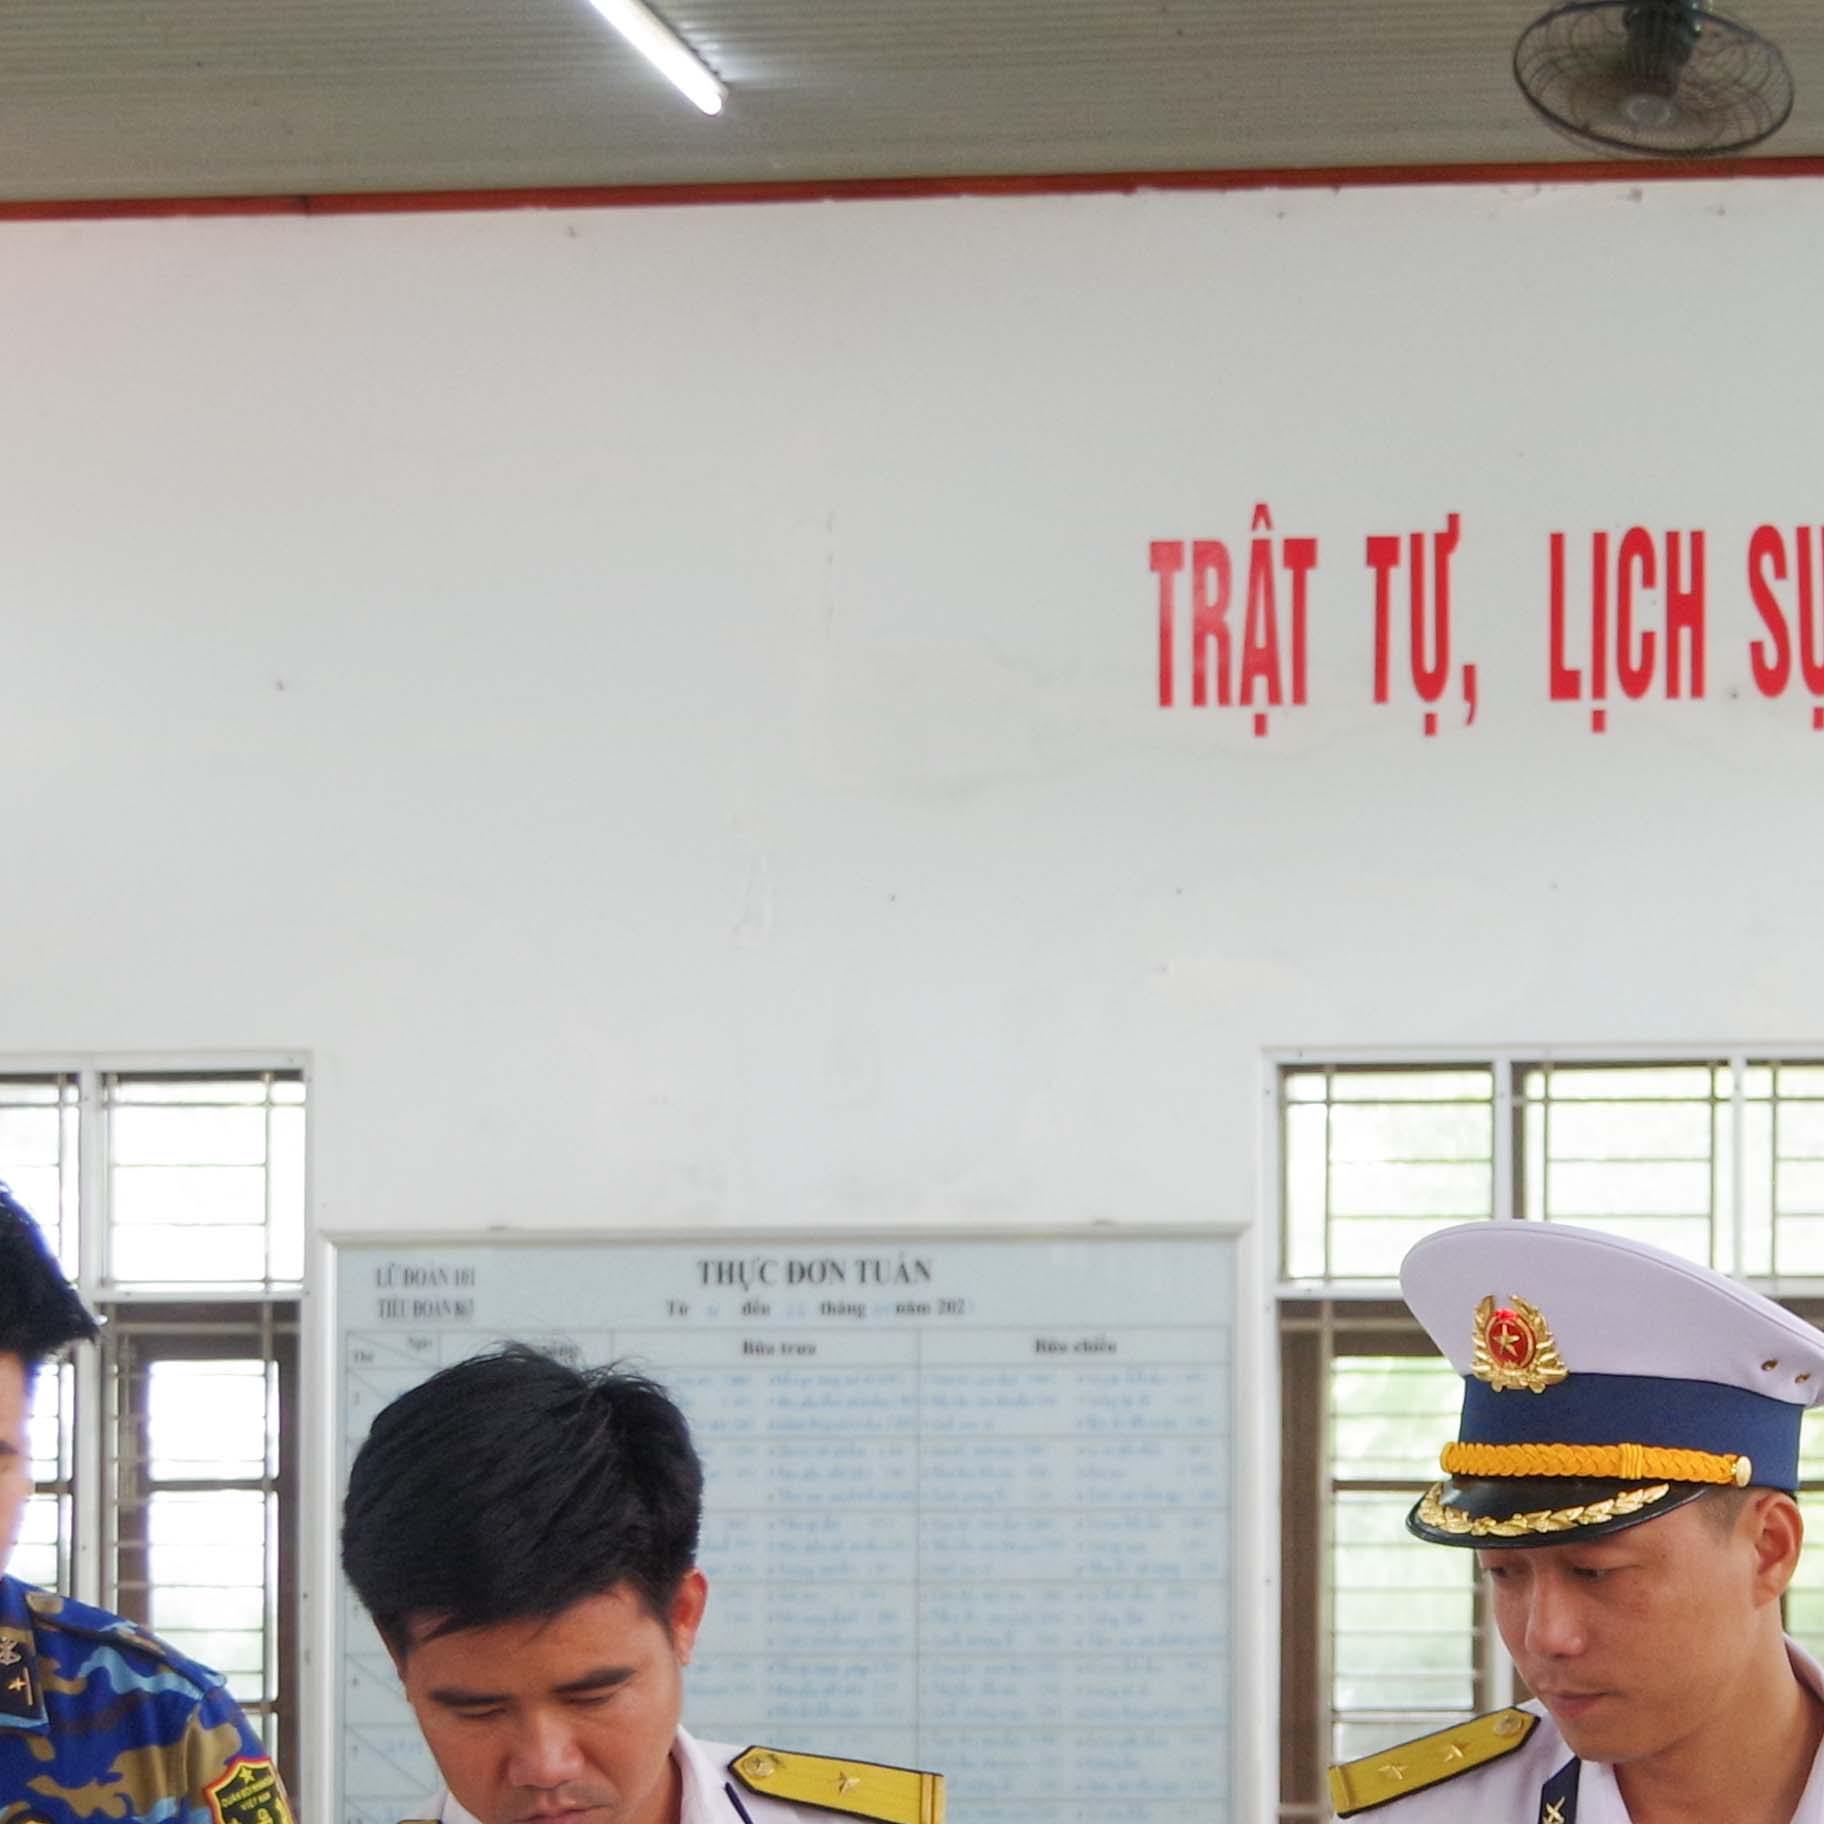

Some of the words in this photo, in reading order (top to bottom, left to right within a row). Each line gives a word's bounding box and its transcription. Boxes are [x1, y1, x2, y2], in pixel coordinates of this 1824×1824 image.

[1150, 503, 1318, 737] TRẬT
[1366, 513, 1478, 736] TỰ,
[1549, 524, 1706, 733] LỊCH
[698, 1256, 778, 1292] THỰC
[785, 1257, 847, 1286] ĐƠN
